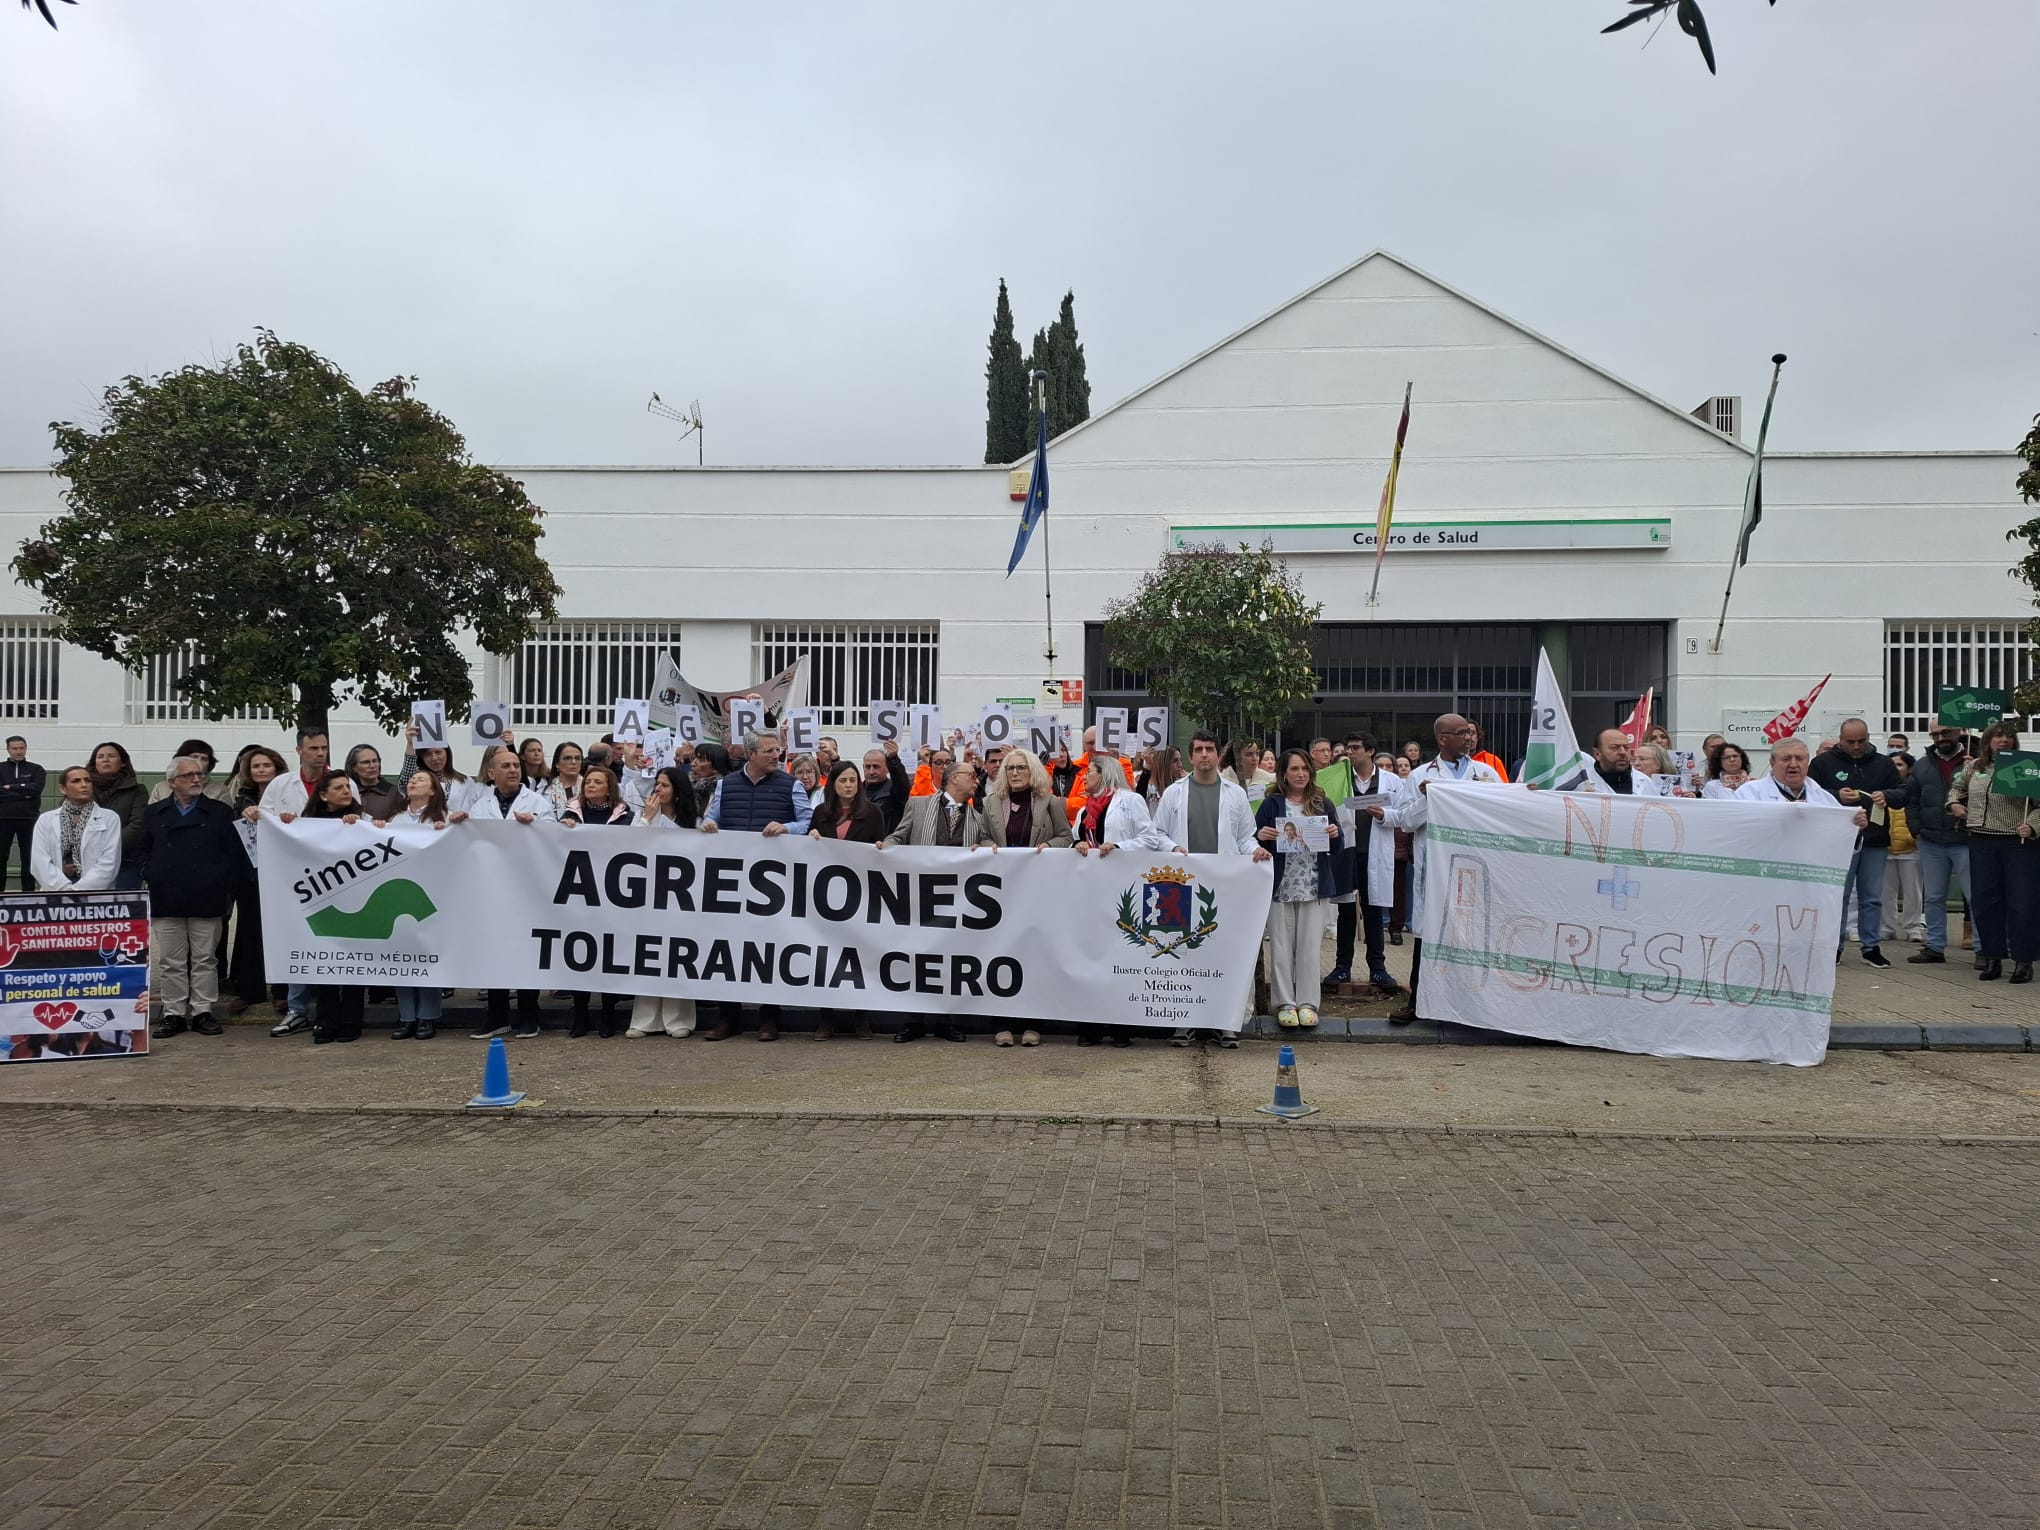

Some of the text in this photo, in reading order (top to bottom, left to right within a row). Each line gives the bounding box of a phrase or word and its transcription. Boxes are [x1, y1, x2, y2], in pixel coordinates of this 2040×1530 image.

[1353, 531, 1478, 545] Cero de Salud
[415, 713, 443, 743] N
[475, 713, 504, 739] O
[618, 710, 643, 735] A
[680, 716, 697, 741] G
[738, 711, 757, 736] R
[793, 717, 813, 748] E
[877, 710, 898, 740] S
[921, 714, 929, 745] I
[984, 714, 1009, 741] O
[1103, 717, 1121, 747] E
[1143, 717, 1161, 747] S
[1727, 724, 1761, 732] Centro
[1031, 726, 1055, 754] N
[1563, 796, 1684, 864] NO
[293, 836, 403, 904] simex
[553, 850, 1003, 931] AGRESIONES
[13, 910, 24, 922] A
[28, 908, 46, 922] LA
[48, 905, 130, 921] VIOLENCIA
[20, 922, 131, 937] CONTRA NUESTROS
[21, 936, 97, 950] SANITARIOS!
[290, 951, 439, 963] SINDICATO MÉDICO
[531, 929, 1024, 998] TOLERANCIA CERO
[4, 972, 107, 987] Respeto y apoyo
[289, 965, 429, 977] DE EXTREMADURA
[1113, 965, 1224, 978] Ilustre Colegio Oficial de
[6, 986, 63, 1001] personal
[66, 986, 80, 996] de
[82, 982, 121, 996] salud
[1144, 980, 1192, 991] Médicos
[1128, 993, 1207, 1004] de la Provincia de
[1145, 1006, 1190, 1021] Badajoz
